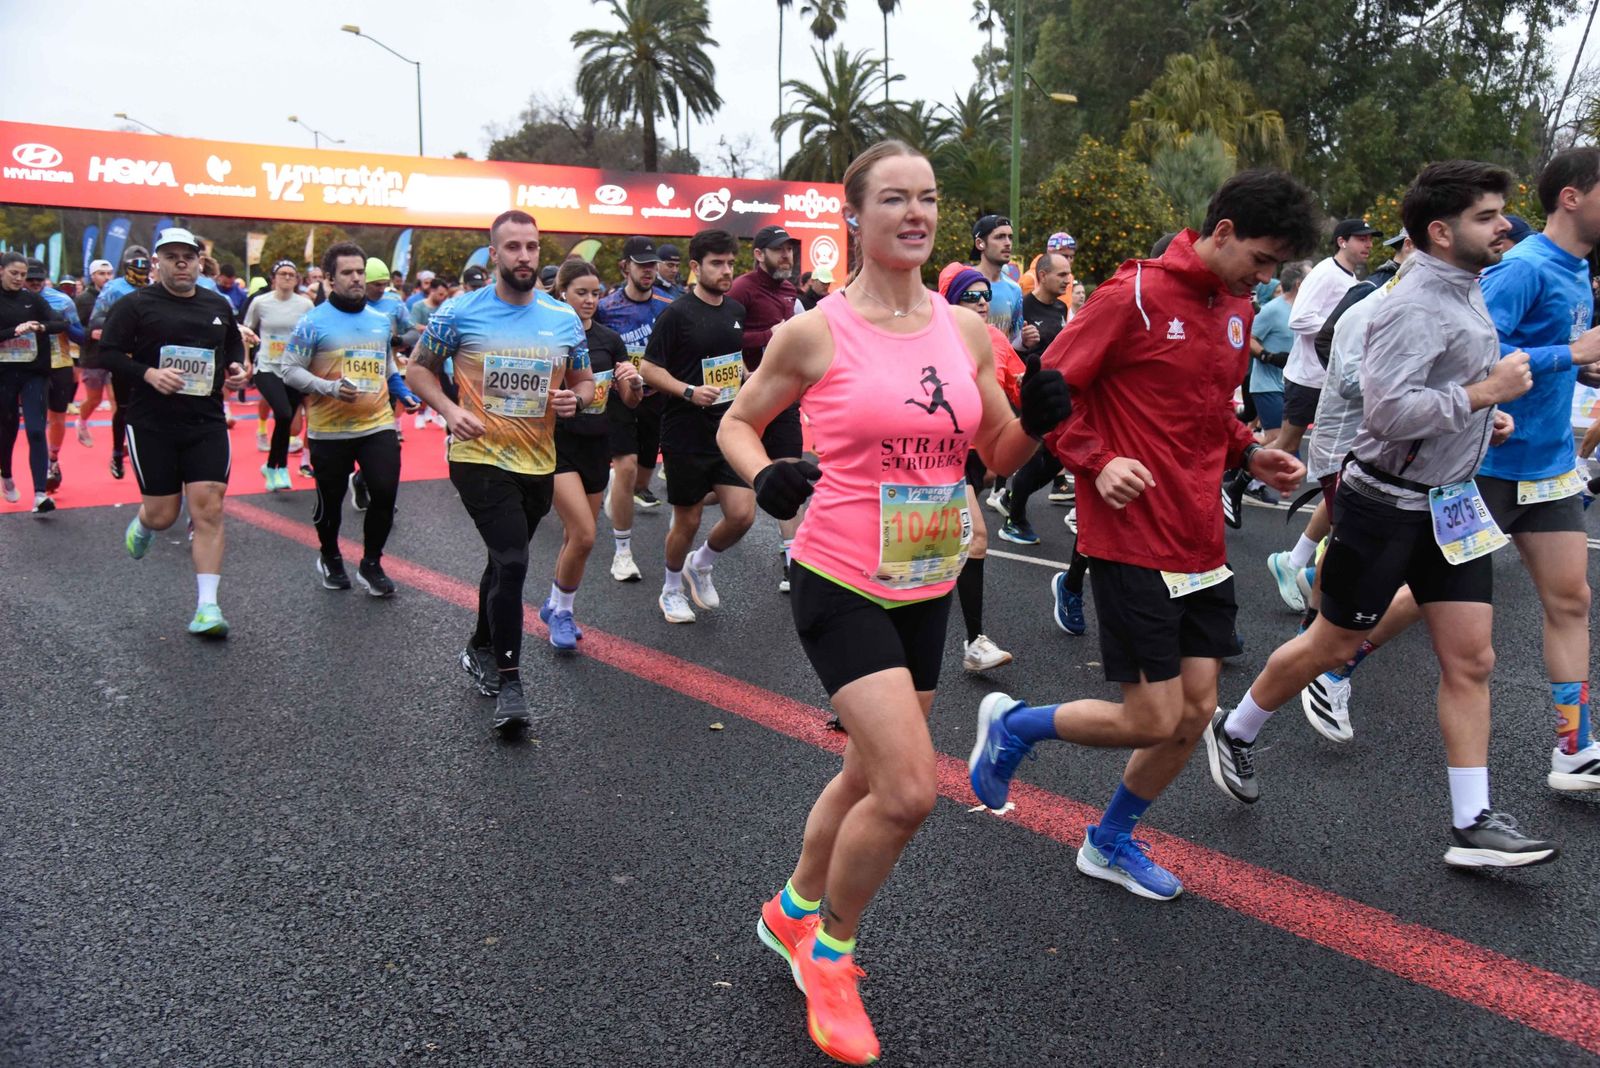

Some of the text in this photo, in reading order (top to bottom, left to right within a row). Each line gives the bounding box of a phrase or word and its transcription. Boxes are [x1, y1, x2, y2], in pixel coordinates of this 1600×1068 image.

[3, 166, 74, 183] HYUNDAI
[88, 155, 179, 187] HOKA
[516, 184, 580, 209] HOKA
[165, 357, 207, 375] 20007
[346, 360, 379, 374] 16418
[708, 364, 739, 384] 16593
[488, 371, 540, 391] 20960
[881, 454, 963, 472] STRIDERS
